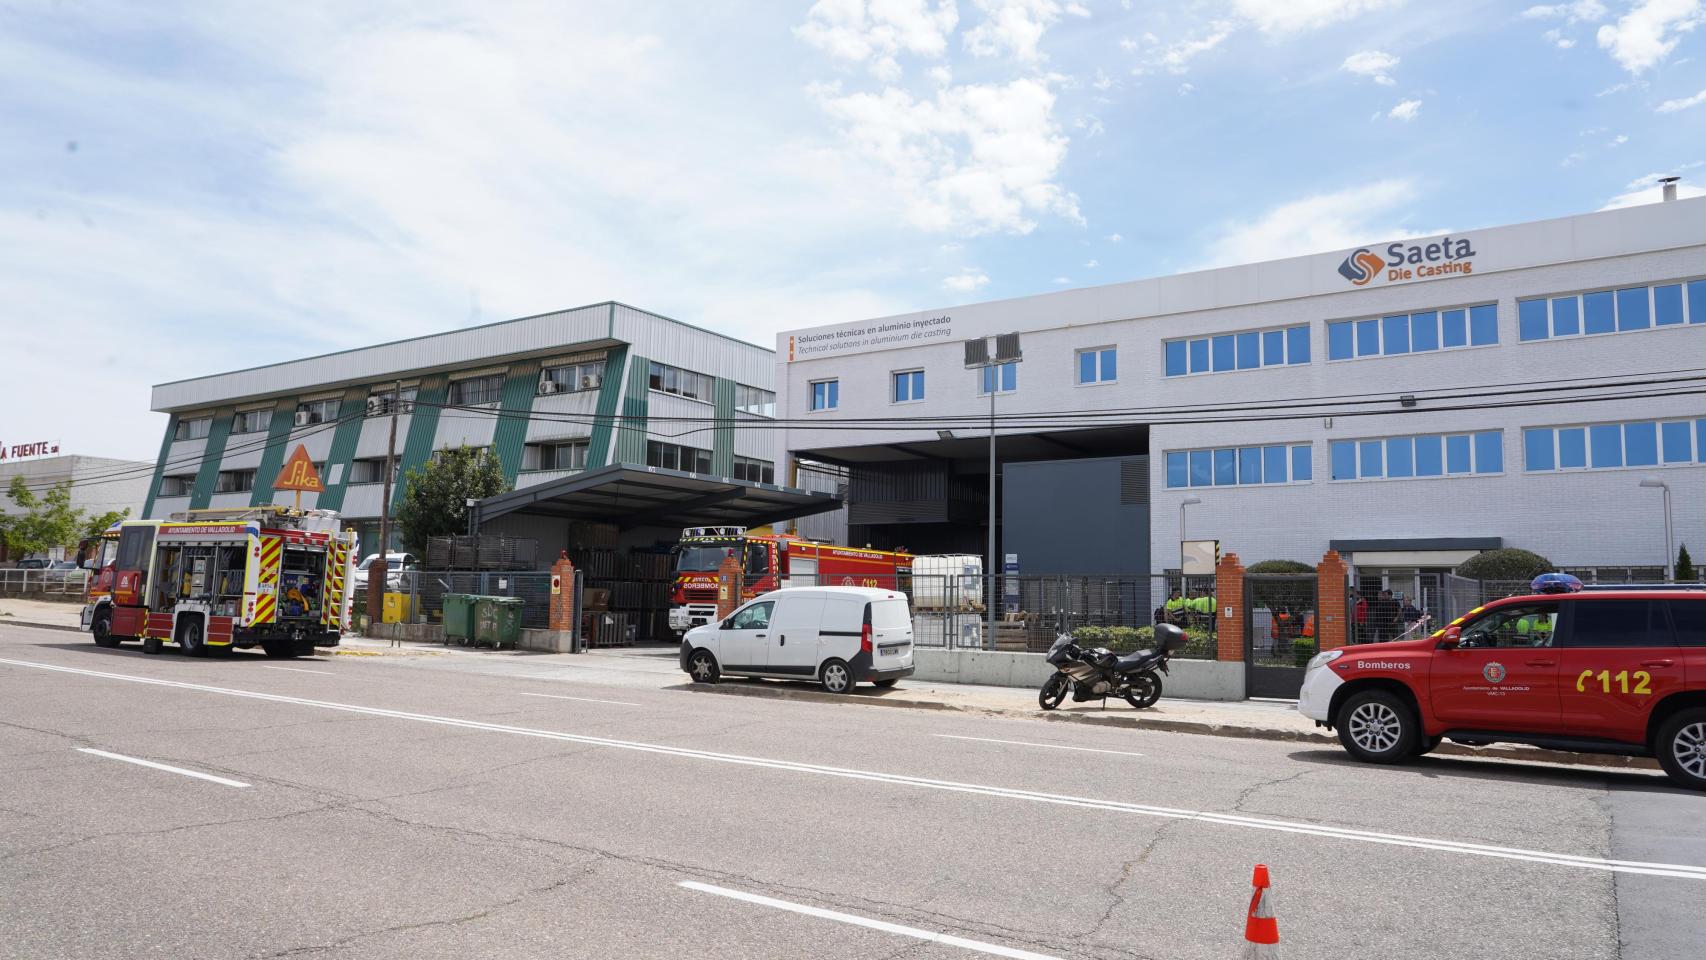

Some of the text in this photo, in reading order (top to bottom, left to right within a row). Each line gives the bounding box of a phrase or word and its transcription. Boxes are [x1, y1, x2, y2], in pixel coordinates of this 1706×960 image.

[1387, 237, 1476, 267] Saeta
[1388, 261, 1472, 281] Die Casting
[798, 316, 951, 344] Soluciones técnicas en aluminio inyectado
[798, 327, 952, 354] Technical solutions in aluminium die casting
[11, 441, 49, 458] FUENTE
[283, 460, 319, 488] Sika
[1357, 660, 1411, 669] Bomberos
[1597, 670, 1652, 694] 112
